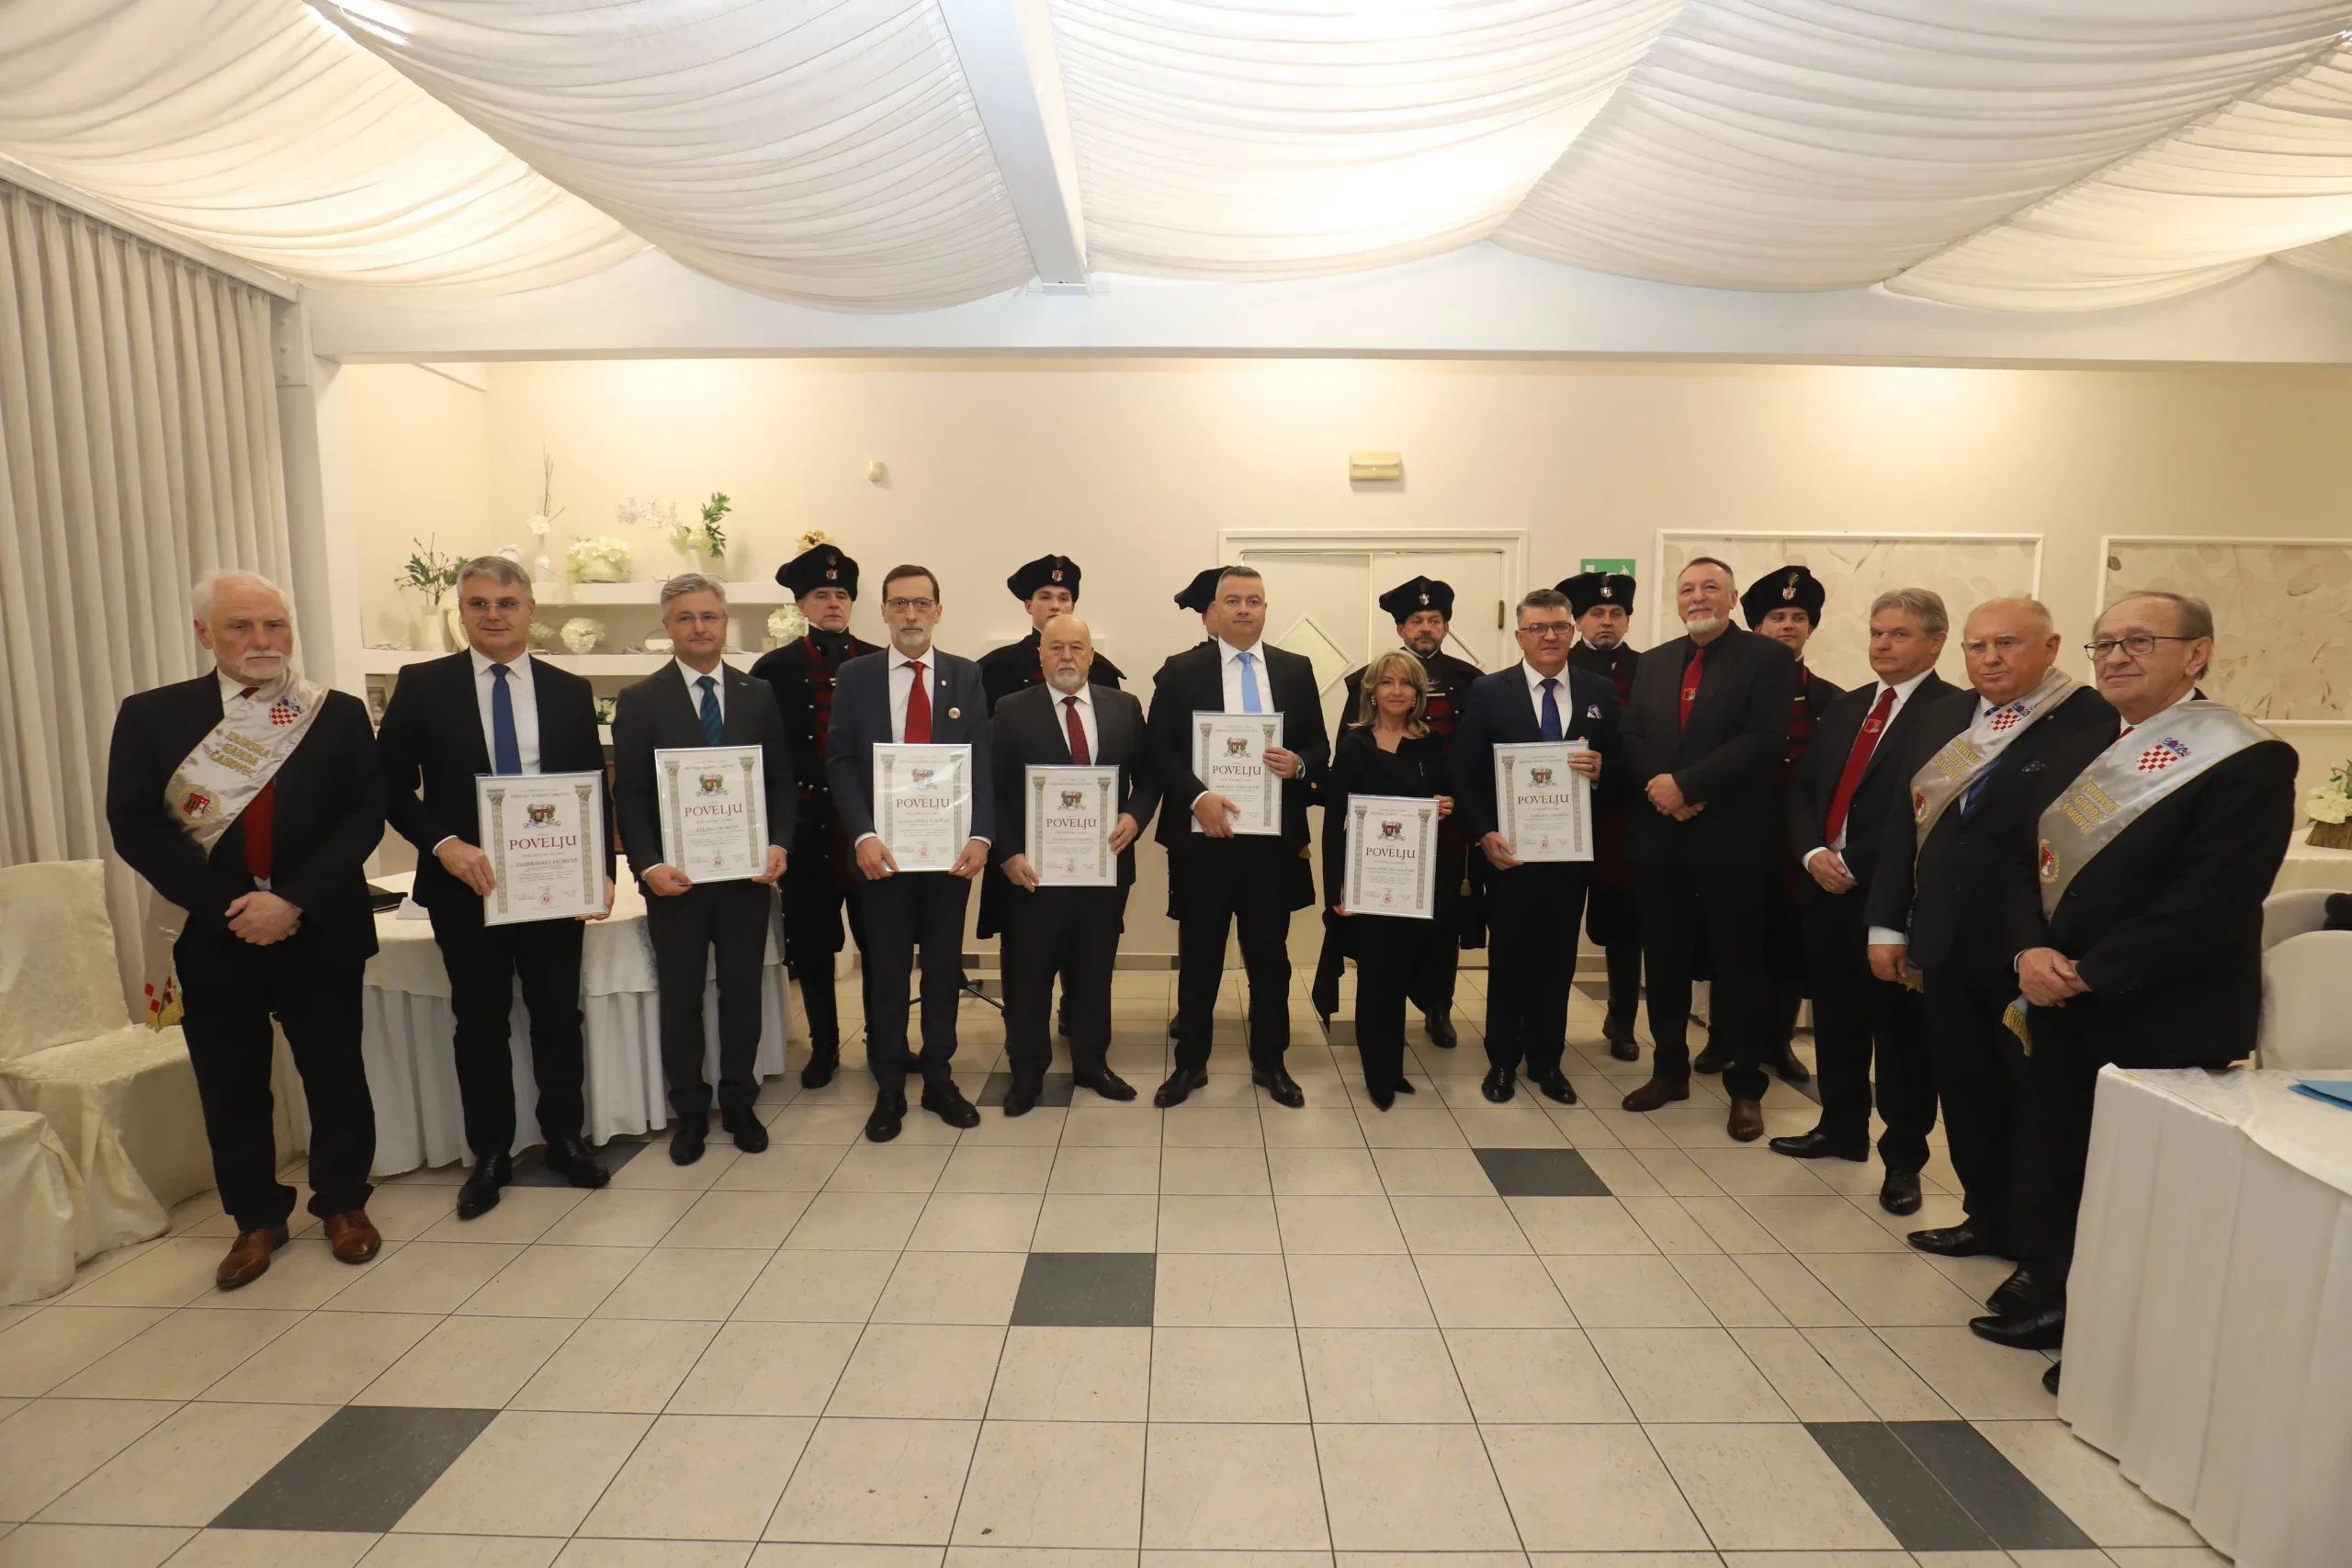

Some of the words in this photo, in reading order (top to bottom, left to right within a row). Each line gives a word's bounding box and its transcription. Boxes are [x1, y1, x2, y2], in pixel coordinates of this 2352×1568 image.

[221, 743, 260, 767] GARDA
[1212, 765, 1261, 777] POVELJU
[896, 798, 950, 809] POVELJU
[1518, 794, 1569, 806] POVELJU
[684, 803, 743, 818] POVELJU
[2074, 794, 2105, 821] GARDA
[1046, 818, 1097, 829] POVELJU
[509, 835, 578, 850] POVELJU
[1365, 847, 1416, 860] POVELJU
